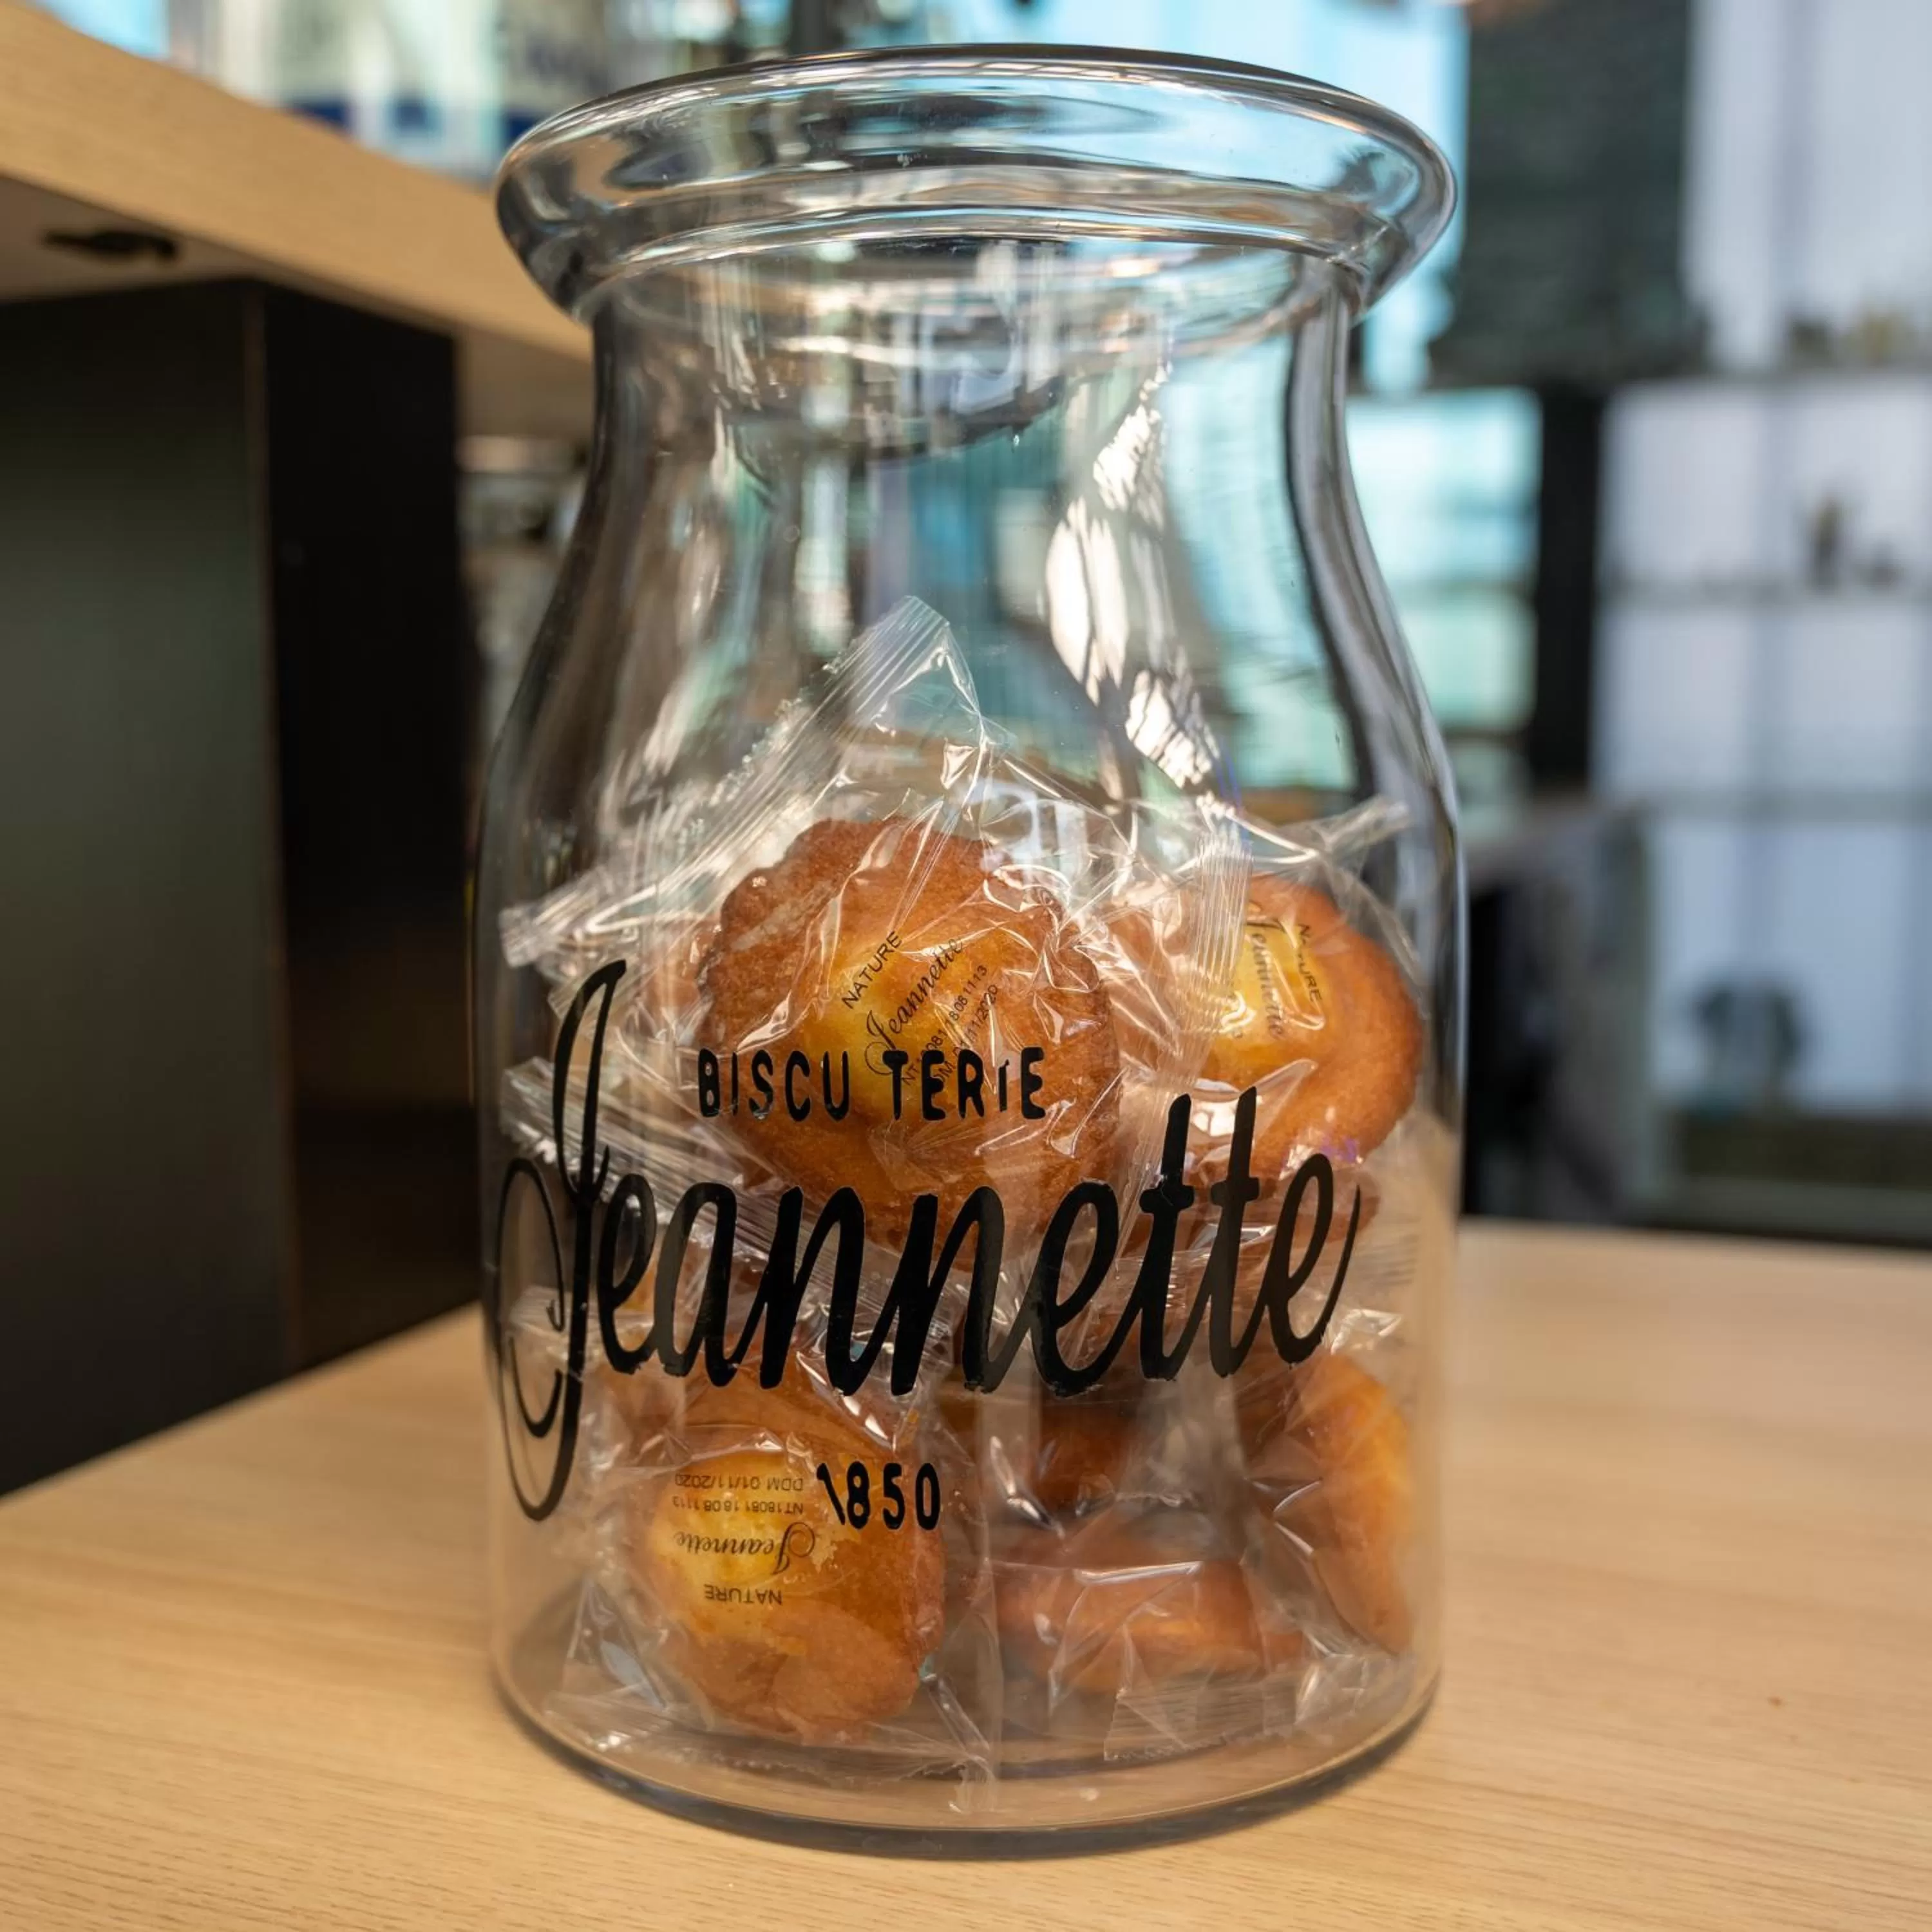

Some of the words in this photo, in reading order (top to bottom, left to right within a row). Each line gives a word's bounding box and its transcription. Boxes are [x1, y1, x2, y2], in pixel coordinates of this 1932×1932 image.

[841, 931, 902, 1009] NATURE
[1298, 923, 1323, 1001] NURE
[864, 938, 963, 1075] Jeannette
[497, 959, 1361, 1521] Jeannette
[675, 1473, 761, 1490] 01/11/2020
[766, 1477, 804, 1492] DDM
[816, 1461, 941, 1531] 1850
[674, 1521, 816, 1575] Jeannette
[704, 1584, 783, 1605] NATURE
